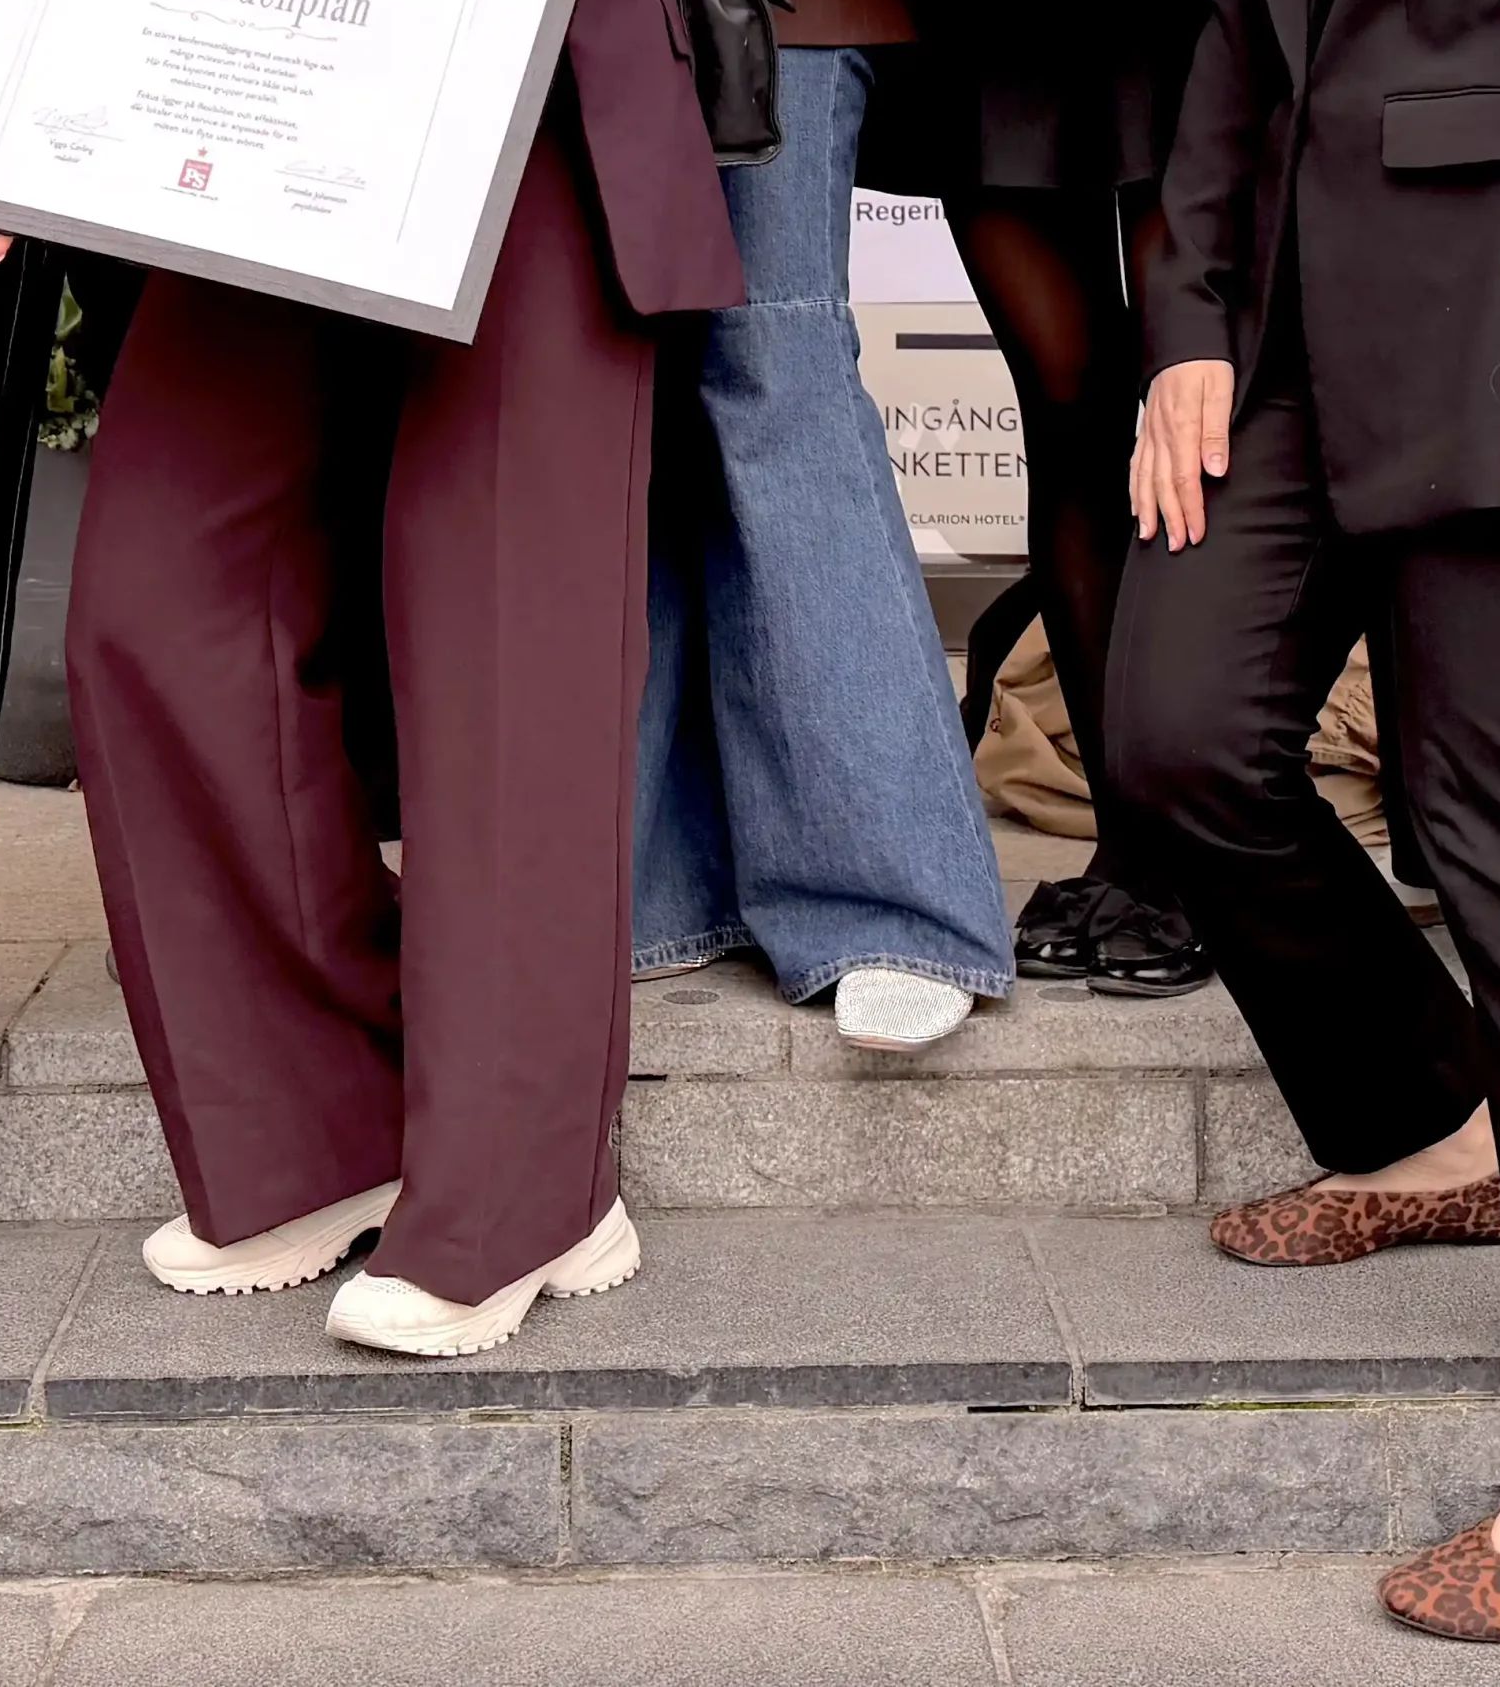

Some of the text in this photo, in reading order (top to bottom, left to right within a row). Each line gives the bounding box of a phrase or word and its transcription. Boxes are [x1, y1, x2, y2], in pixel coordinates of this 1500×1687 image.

[856, 200, 945, 226] Regeri
[885, 398, 1018, 432] INGÅNG
[910, 514, 970, 525] CLARION
